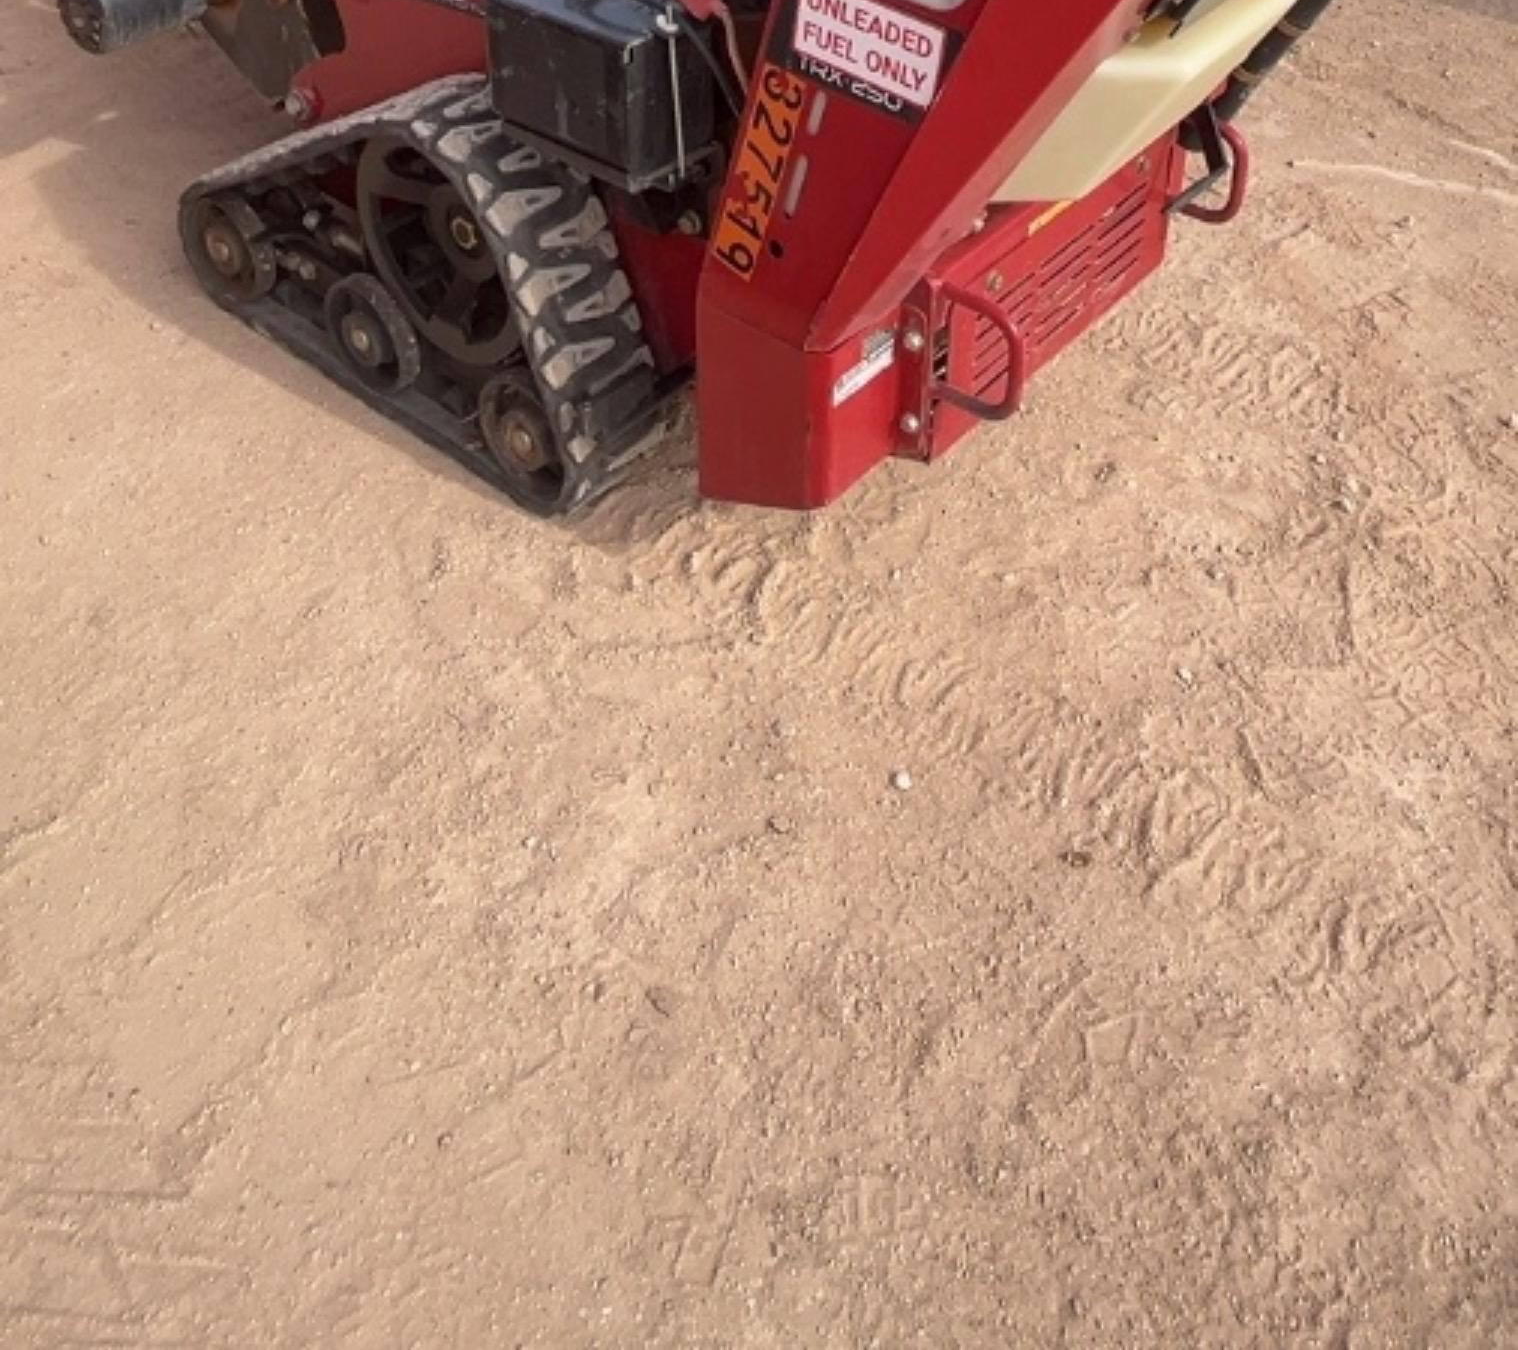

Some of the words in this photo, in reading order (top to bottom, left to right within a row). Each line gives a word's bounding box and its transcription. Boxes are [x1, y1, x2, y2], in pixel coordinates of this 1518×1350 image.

[803, 21, 859, 64] FUEL
[865, 49, 928, 91] ONLY
[717, 69, 802, 275] 327519
